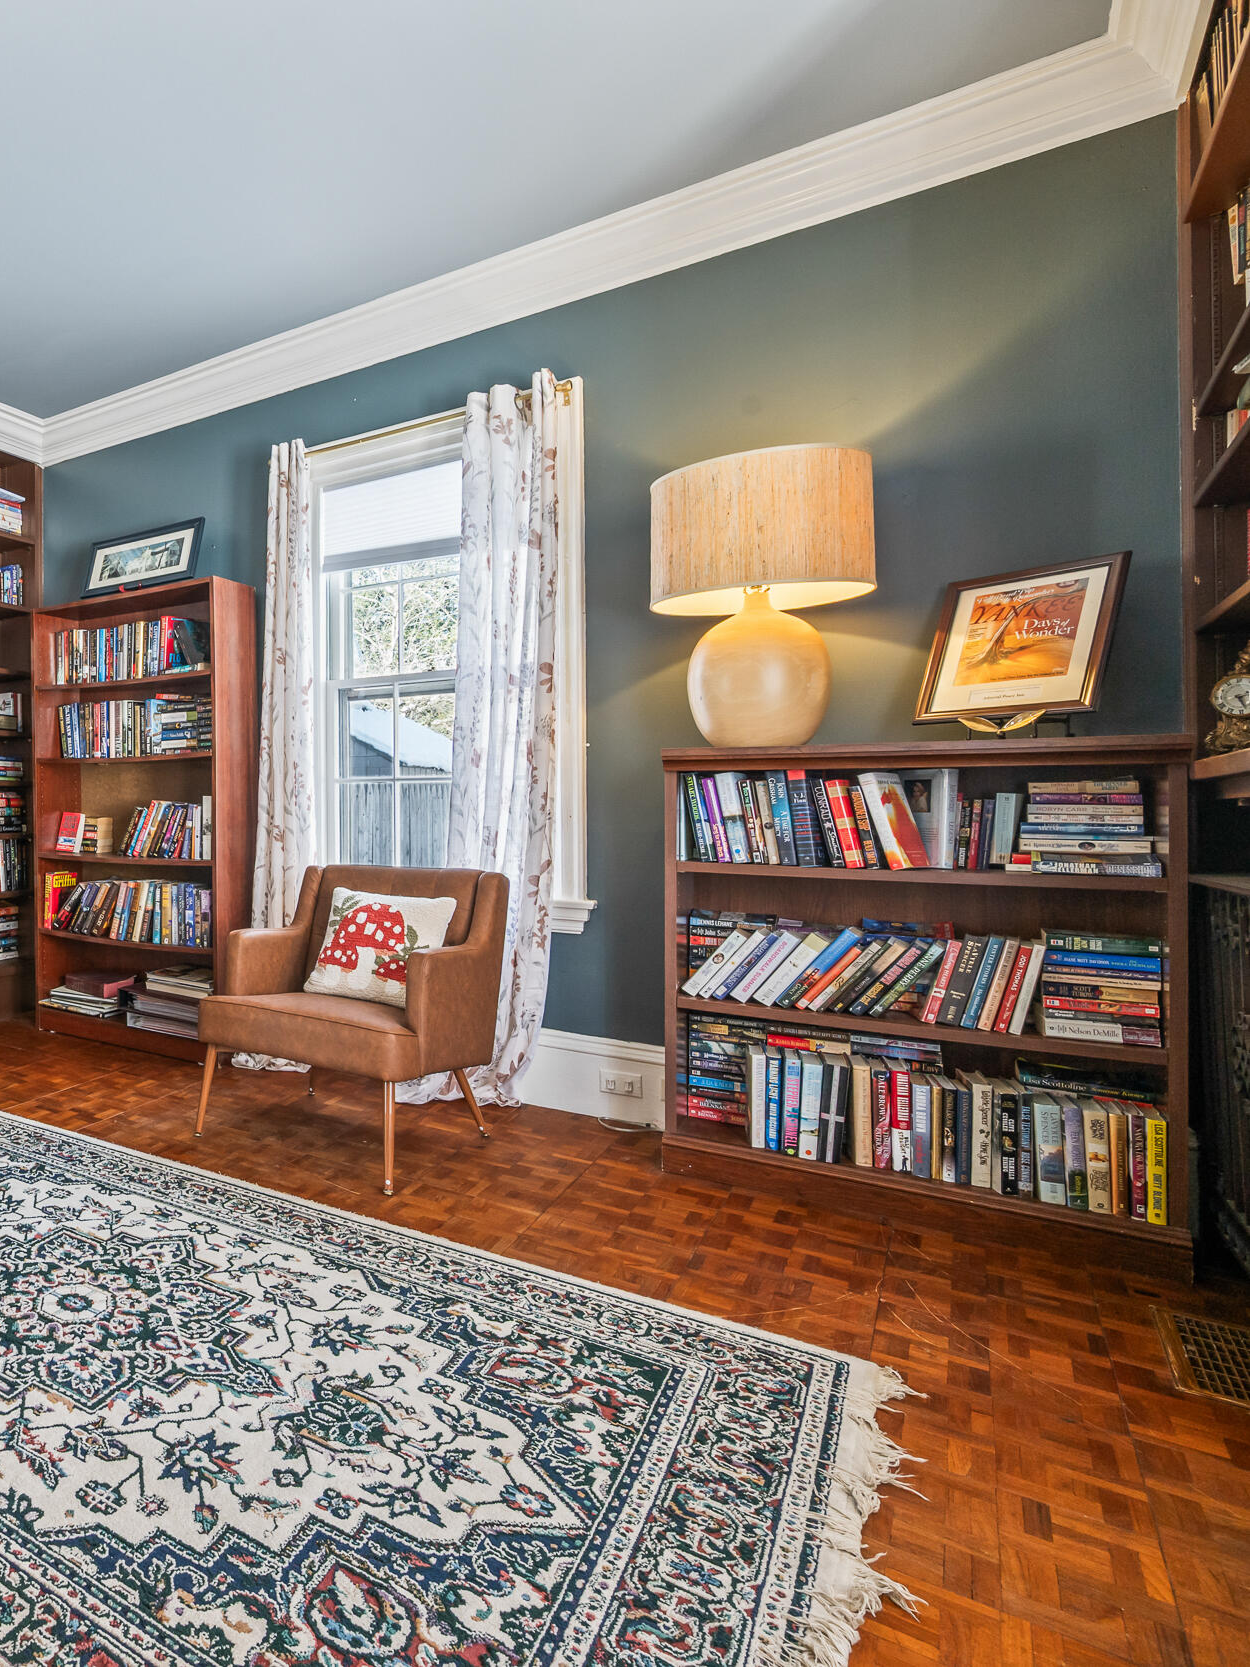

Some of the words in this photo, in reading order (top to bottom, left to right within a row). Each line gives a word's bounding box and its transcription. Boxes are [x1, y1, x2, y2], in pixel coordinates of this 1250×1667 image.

[969, 595, 1083, 625] YANKEE
[1015, 625, 1075, 640] Wonder
[1023, 618, 1060, 630] Days
[1060, 618, 1080, 626] of
[687, 776, 695, 799] STUART
[769, 778, 777, 804] GRISHAM
[777, 783, 785, 798] JOHN
[815, 786, 830, 820] CONRAD
[781, 816, 789, 831] TIME
[1056, 861, 1097, 869] JONATHAN
[697, 918, 715, 927] DENNIS
[715, 919, 733, 928] LEHANE
[759, 941, 788, 972] BOARDWALK
[916, 949, 936, 970] ANNE
[958, 940, 975, 973] SPENCER
[1017, 954, 1028, 967] JODI
[741, 971, 762, 993] SUMMER
[899, 965, 921, 989] PERRY
[1011, 970, 1023, 991] THOMAS
[1069, 1027, 1092, 1035] Nelson
[1093, 1028, 1120, 1038] DeMille
[769, 1059, 779, 1083] WARNING
[922, 1064, 939, 1073] Envy
[769, 1083, 778, 1099] LIGHT
[786, 1077, 799, 1108] STEPHEN
[878, 1075, 886, 1094] DALE
[896, 1073, 909, 1096] JONATHAN
[1023, 1076, 1041, 1085] Lisa
[1042, 1079, 1087, 1092] Scottoline
[699, 1101, 727, 1110] BRENNAN
[878, 1095, 886, 1122] BROWN
[896, 1097, 910, 1121] KELLERMAN
[915, 1088, 926, 1110] SANDRA
[698, 1111, 717, 1119] BRENNAN
[915, 1111, 926, 1133] BROWN
[1022, 1105, 1030, 1120] FALSE
[784, 1116, 798, 1148] CANNELL
[1040, 1111, 1049, 1144] SPENCER
[1154, 1124, 1164, 1136] LISA
[1021, 1152, 1030, 1163] ROSE
[1154, 1136, 1164, 1168] SCOTTOLINE
[1021, 1164, 1030, 1184] CONNO
[1153, 1173, 1162, 1188] DIRTY
[1152, 1190, 1162, 1210] BLONDE
